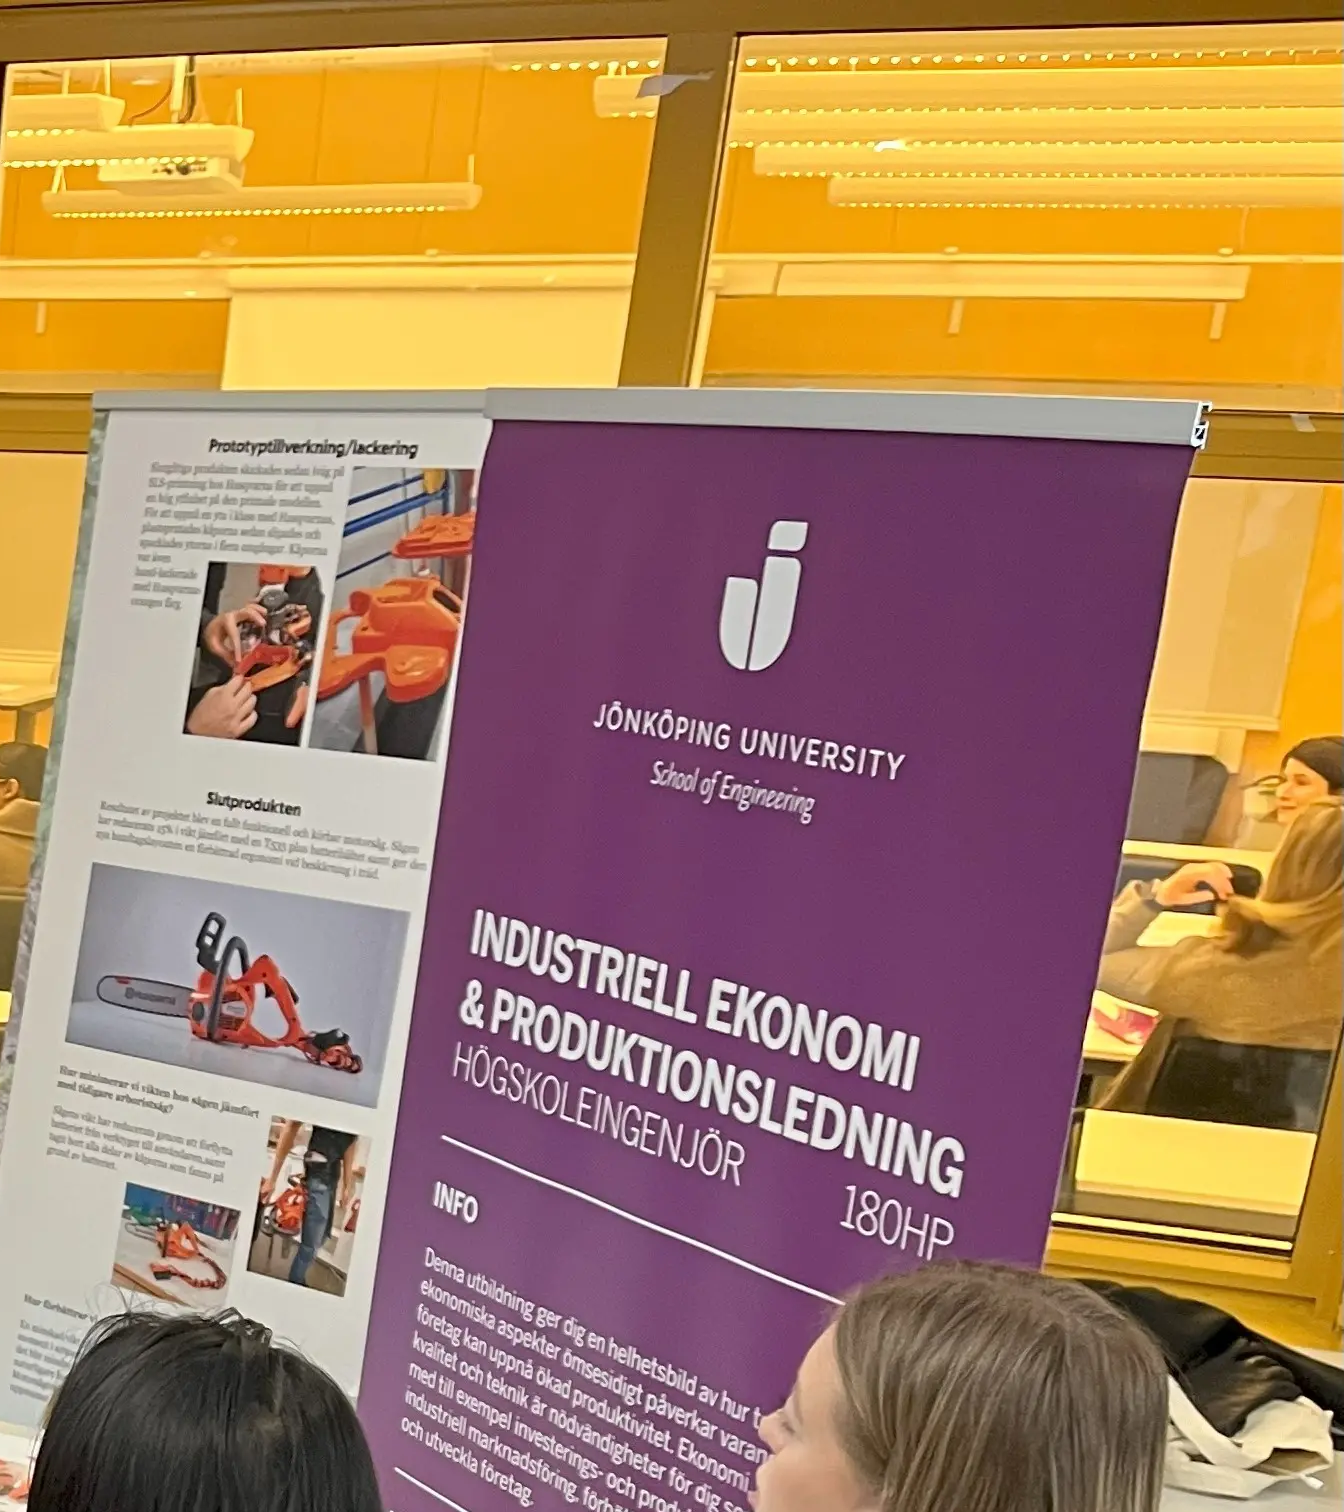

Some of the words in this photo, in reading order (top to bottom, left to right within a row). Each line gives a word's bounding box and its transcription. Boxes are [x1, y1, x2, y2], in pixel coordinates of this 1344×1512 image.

[208, 438, 419, 459] Prototyptillverkning/lackering
[206, 791, 302, 817] Slutprodukten
[593, 701, 731, 750] JÖNKÖPING
[739, 727, 906, 780] UNIVERSITY
[650, 760, 700, 793] School
[700, 770, 722, 804] of
[719, 774, 815, 824] Engineering
[471, 908, 698, 1024] INDUSTRIELL
[706, 977, 921, 1092] EKONOMI
[453, 1041, 747, 1186] HÖGSKOLEINGENJÖR
[840, 1184, 954, 1262] 180HP
[459, 979, 485, 1029] &
[490, 987, 966, 1198] PRODUKTIONSLEDNING
[433, 1181, 479, 1224] INFO
[416, 1303, 462, 1348] företag
[463, 1327, 487, 1356] kan
[488, 1344, 534, 1380] uppnå
[536, 1366, 572, 1399] ökad
[572, 1387, 674, 1454] produktivitet.
[420, 1278, 496, 1330] ekonomiska
[497, 1319, 562, 1361] aspekter
[562, 1348, 643, 1406] ömsesidigt
[644, 1393, 718, 1440] påverkar
[720, 1429, 773, 1464] varan
[424, 1246, 464, 1283] Denna
[467, 1272, 535, 1322] utbildning
[535, 1306, 563, 1329] ger
[563, 1317, 587, 1347] dig
[587, 1331, 606, 1354] en
[608, 1336, 698, 1397] helhetsbild
[698, 1385, 719, 1406] av
[720, 1390, 750, 1423] hur
[401, 1417, 424, 1441] och
[425, 1431, 478, 1474] utveckla
[480, 1459, 534, 1508] företag.
[405, 1385, 467, 1436] industriell
[409, 1362, 437, 1389] med
[438, 1375, 455, 1399] till
[455, 1389, 512, 1430] exempel
[514, 1416, 604, 1479] investerings-
[605, 1472, 636, 1499] och
[412, 1329, 459, 1372] kvalitet
[459, 1360, 483, 1384] och
[485, 1371, 529, 1409] teknik
[530, 1396, 549, 1418] är
[548, 1407, 666, 1482] nödvändigheter
[669, 1466, 693, 1494] för
